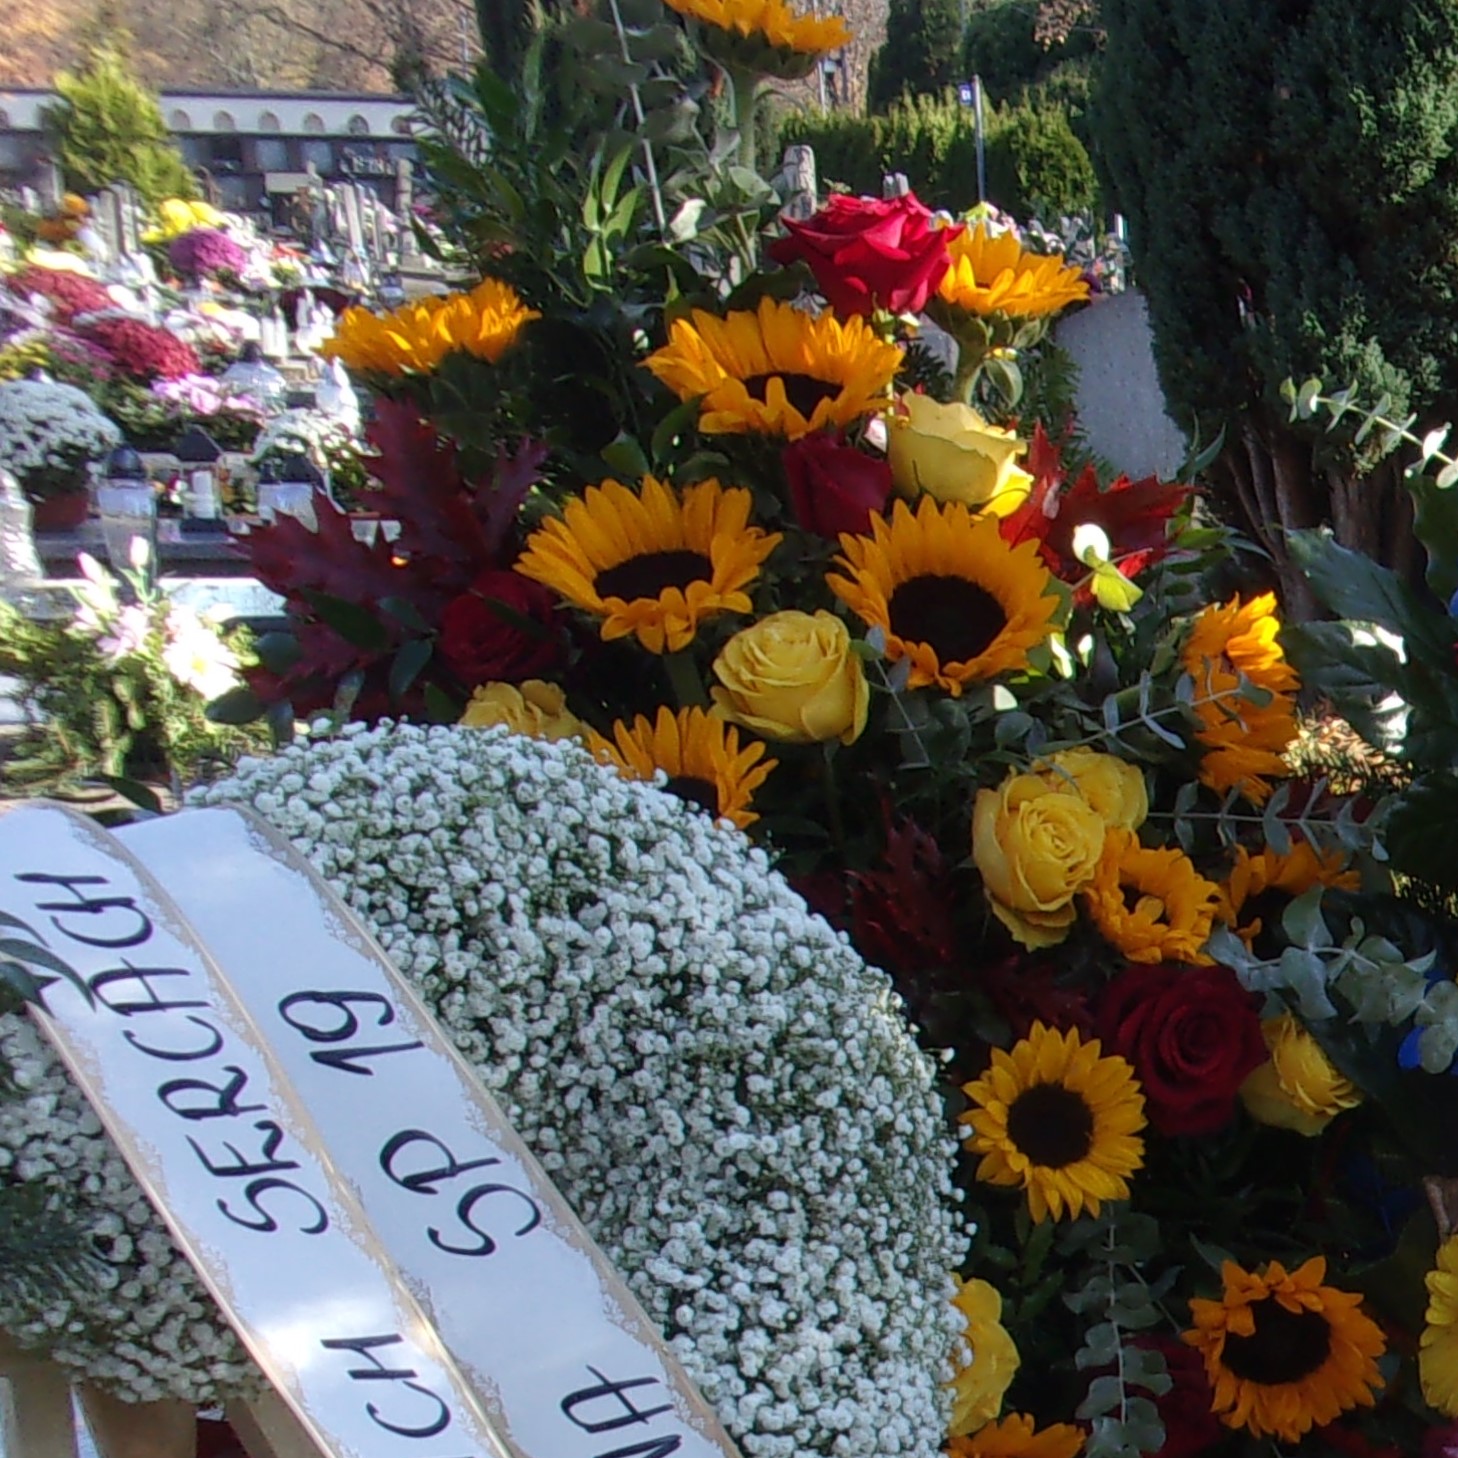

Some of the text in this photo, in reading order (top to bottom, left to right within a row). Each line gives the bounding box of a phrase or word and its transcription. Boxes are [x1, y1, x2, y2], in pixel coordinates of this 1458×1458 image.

[14, 871, 330, 1236] SERCACH
[276, 990, 424, 1077] 19
[378, 1128, 541, 1257] SP
